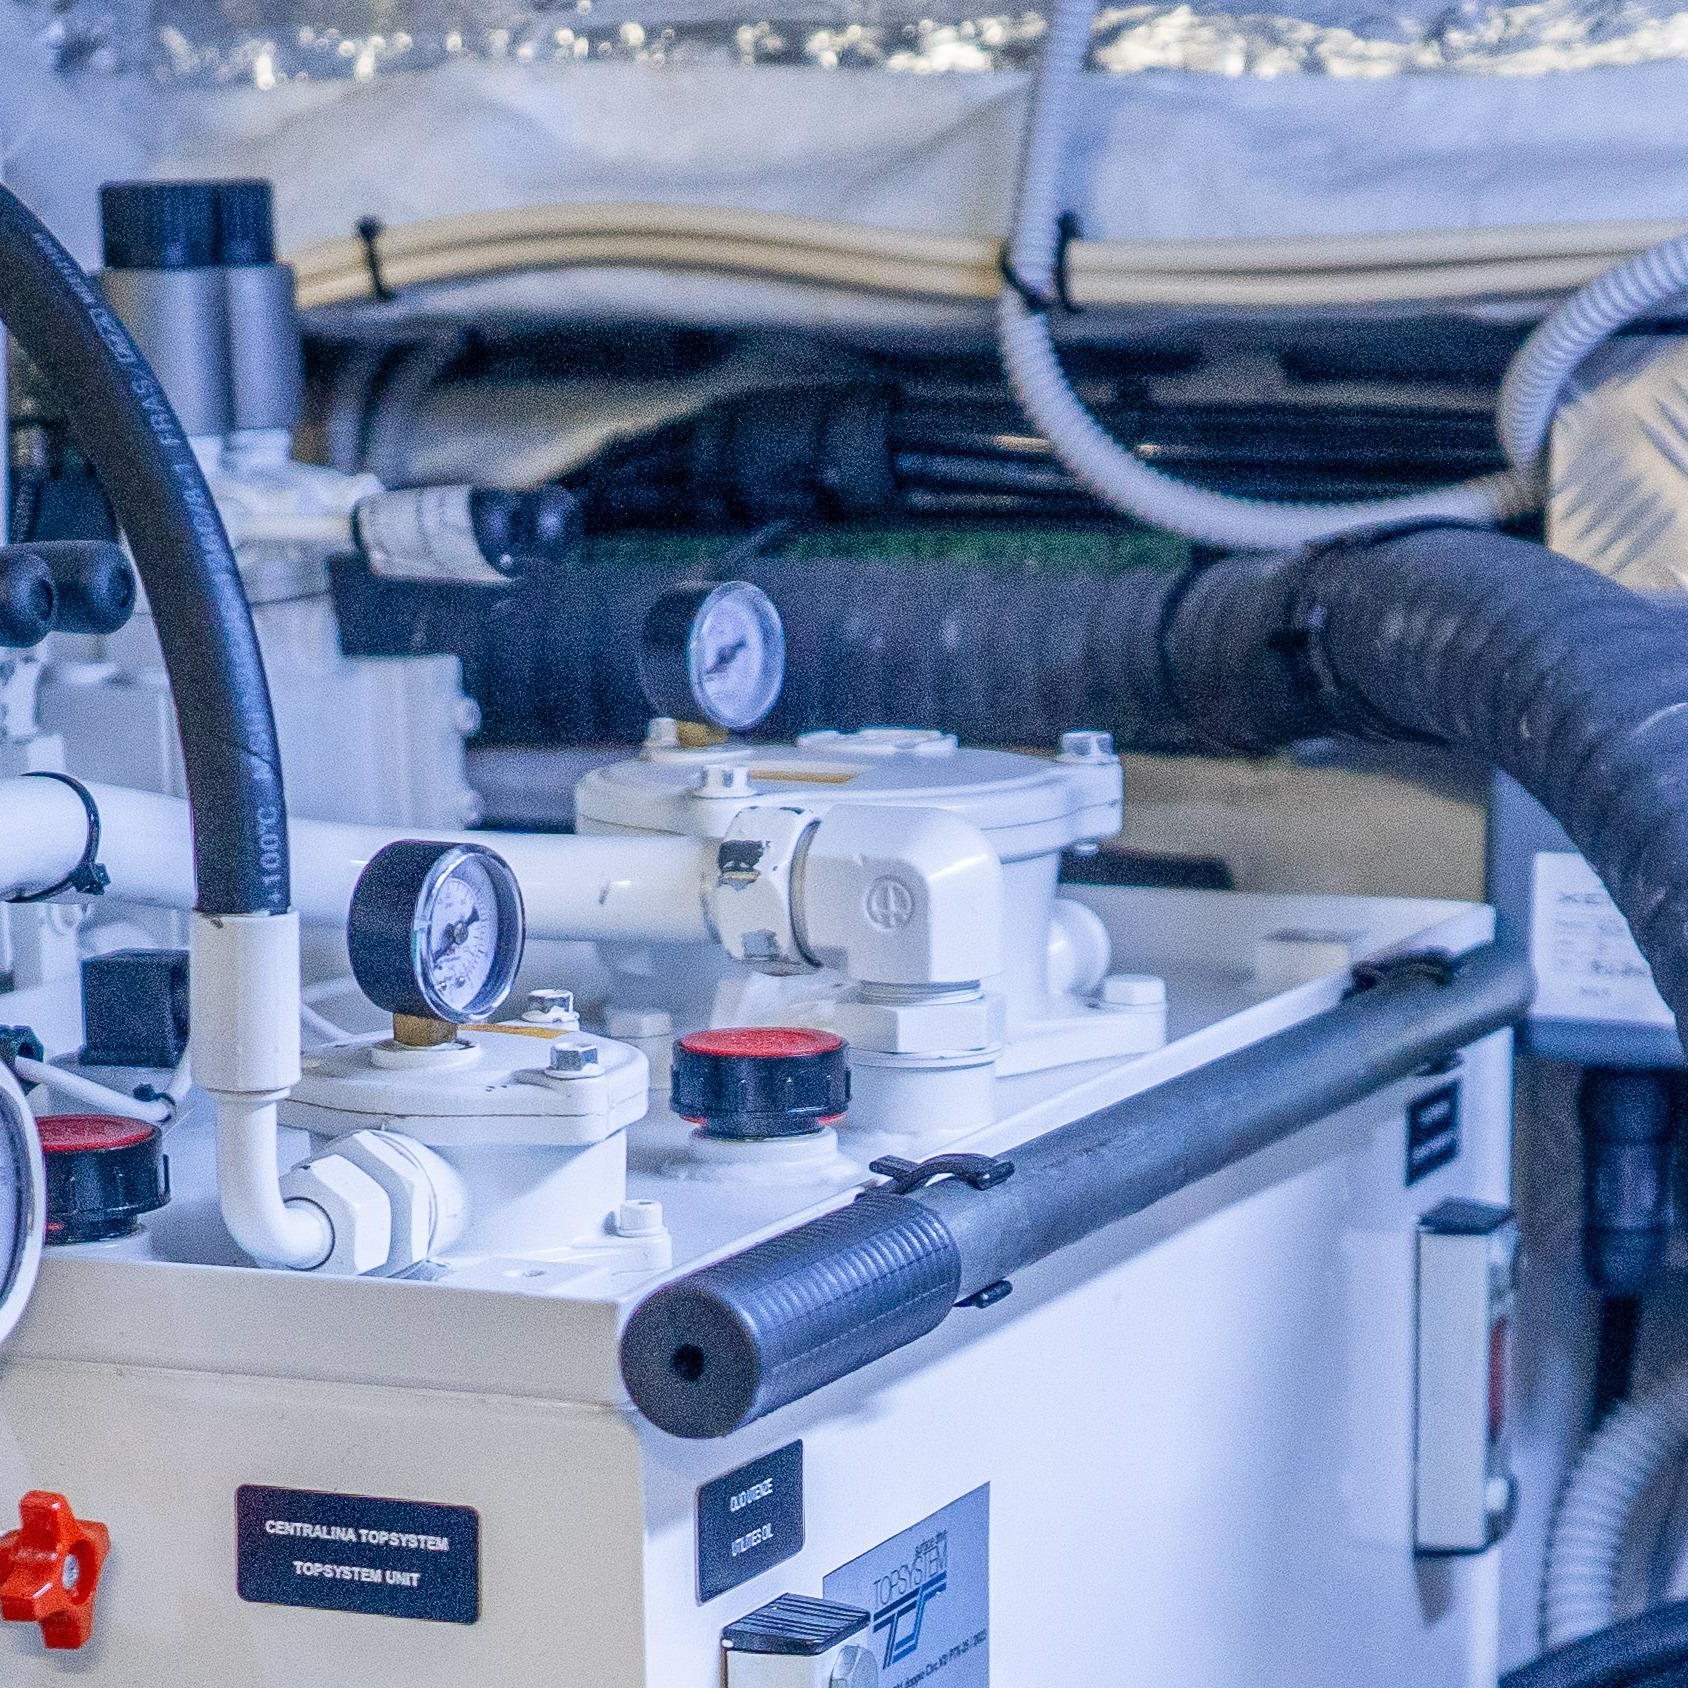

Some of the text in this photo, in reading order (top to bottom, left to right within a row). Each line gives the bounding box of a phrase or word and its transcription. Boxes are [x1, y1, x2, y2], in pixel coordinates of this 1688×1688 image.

[264, 1520, 450, 1551] CENTRALINA TOPSYSTEM
[293, 1561, 421, 1587] TOPSYSTEM UNIT
[873, 1540, 947, 1606] TOPSYSTEM
